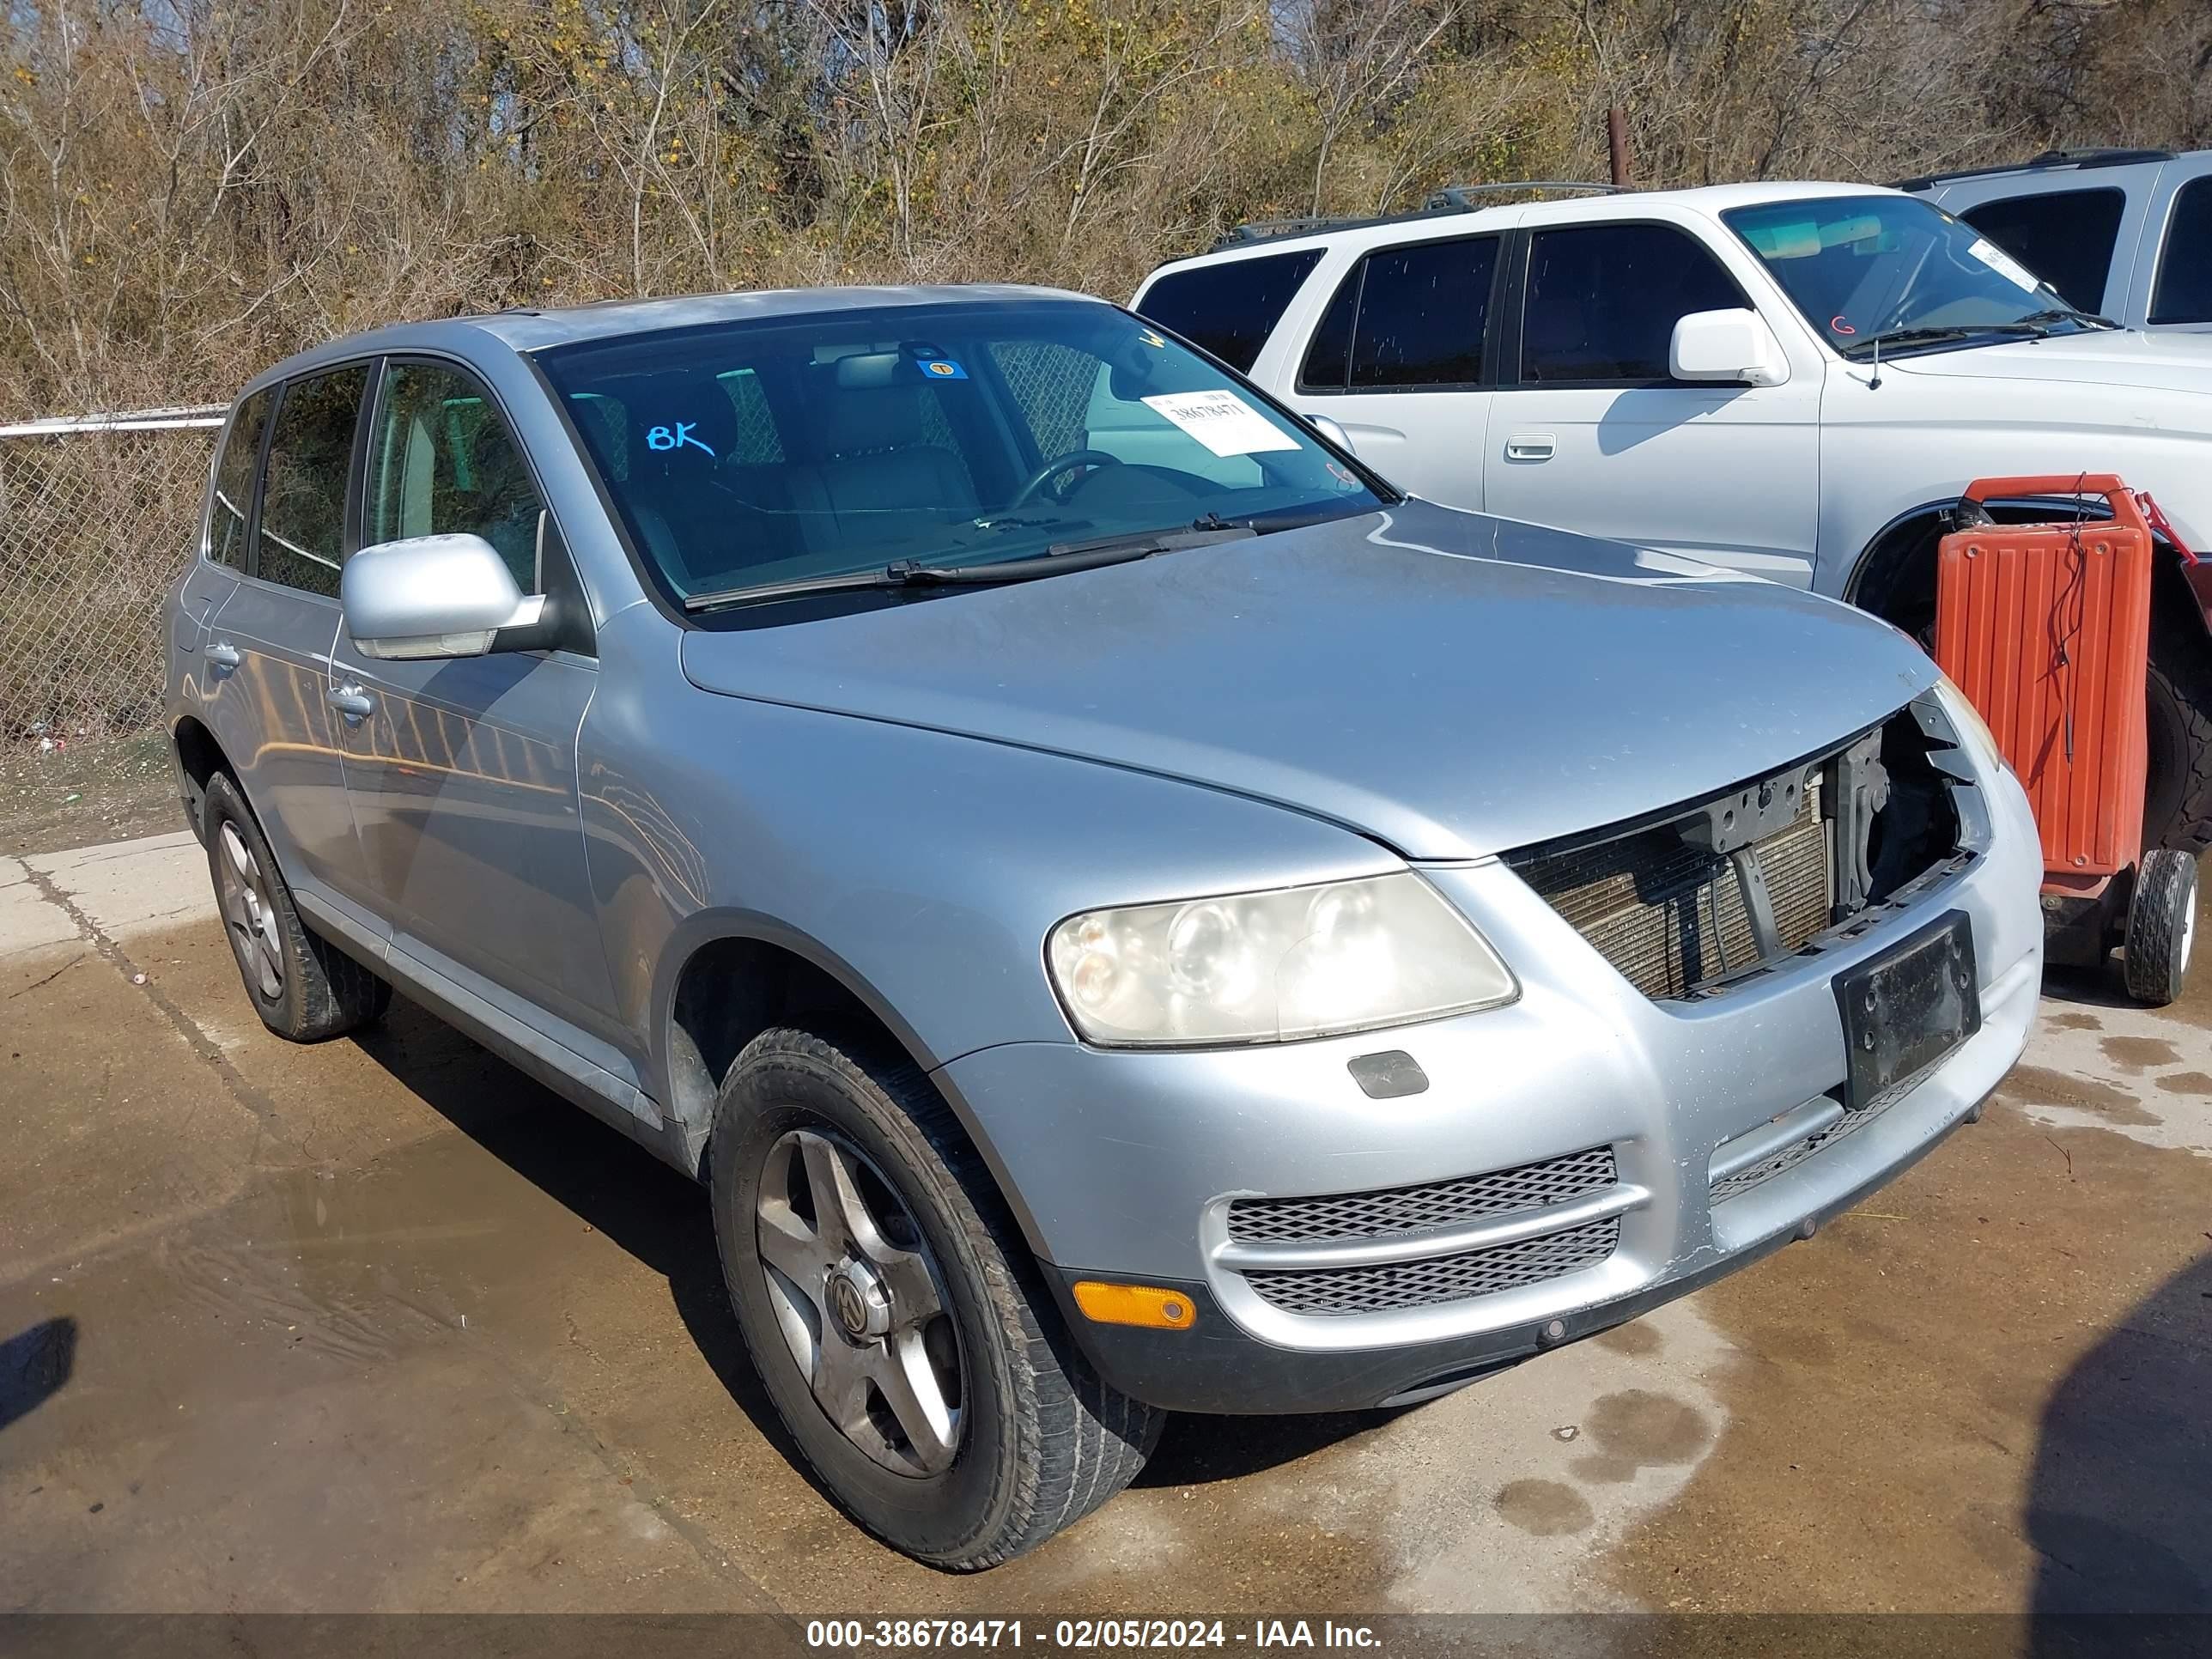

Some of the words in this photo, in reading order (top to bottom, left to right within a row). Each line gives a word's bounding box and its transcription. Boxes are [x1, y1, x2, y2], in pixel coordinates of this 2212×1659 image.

[1831, 315, 1856, 334] G
[1170, 404, 1245, 420] 38678471
[646, 422, 715, 457] BK
